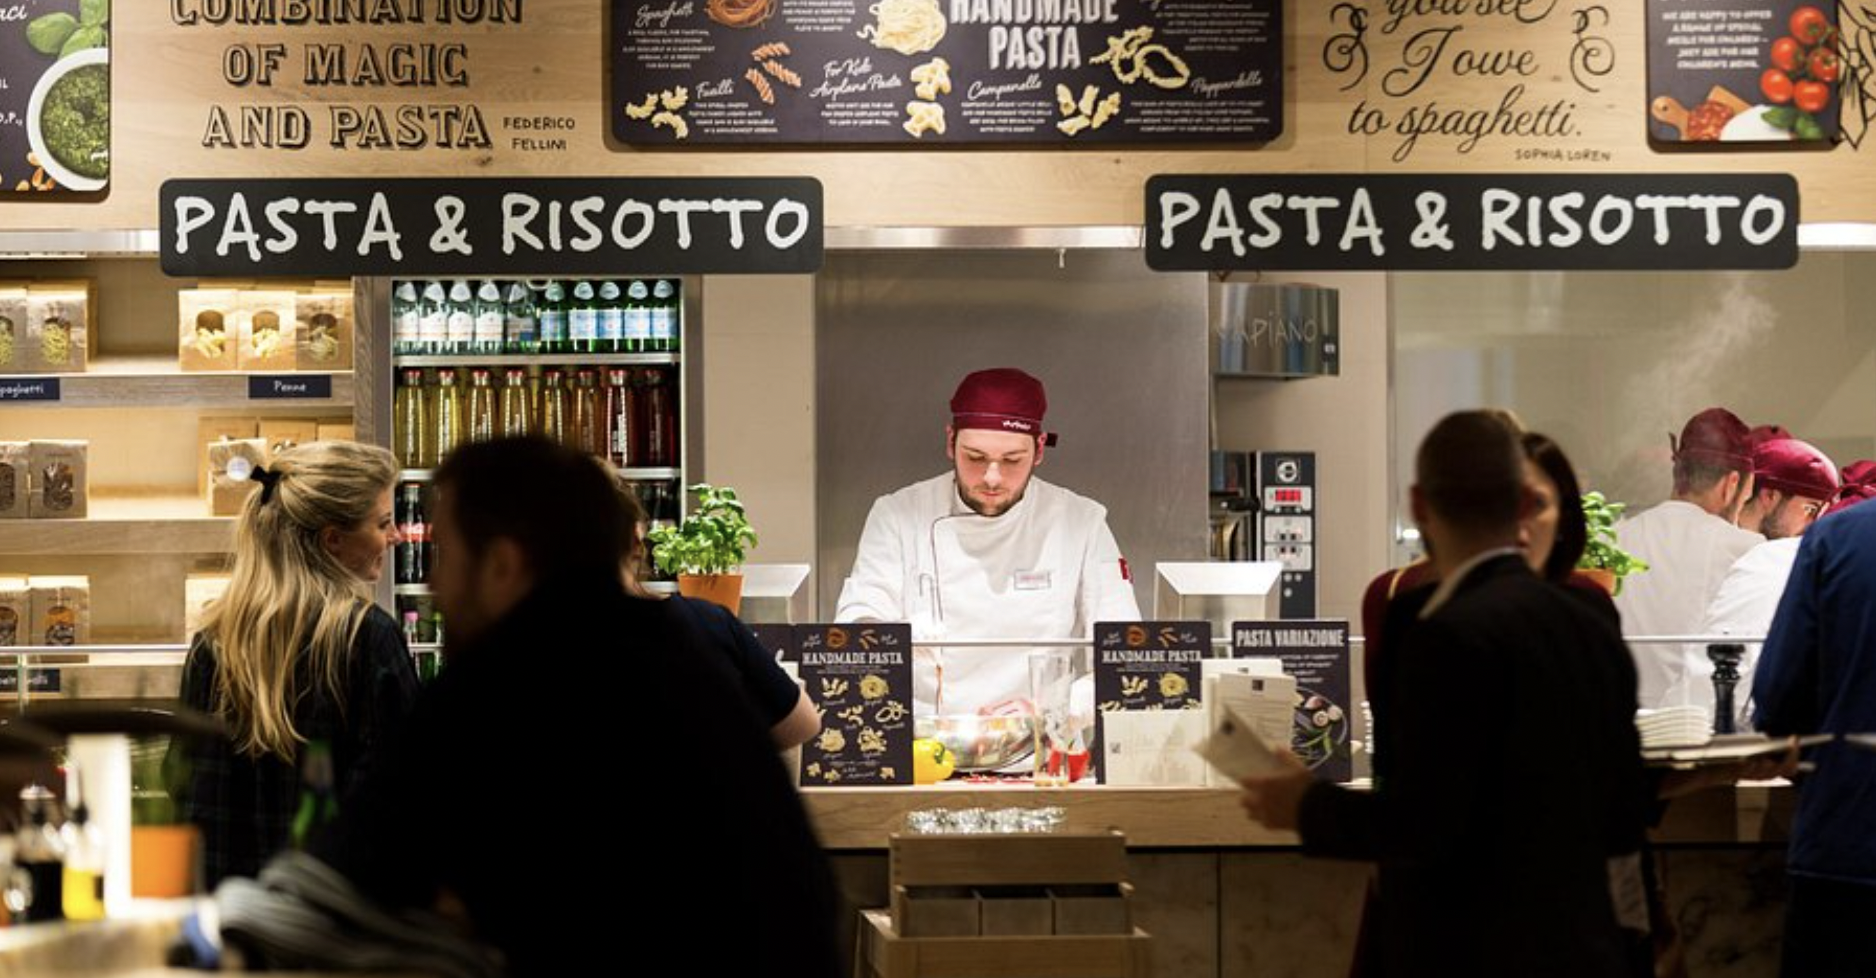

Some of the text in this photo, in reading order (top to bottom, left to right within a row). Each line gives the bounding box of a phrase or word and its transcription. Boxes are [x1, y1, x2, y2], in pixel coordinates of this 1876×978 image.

[988, 25, 1082, 70] PASTA
[222, 44, 469, 87] OF MAGIC
[1453, 49, 1539, 76] owe
[202, 105, 493, 150] AND PASTA
[503, 116, 576, 131] FEDERICO
[1348, 83, 1581, 163] to spaghetti.
[512, 137, 568, 151] FELLINI
[1515, 148, 1611, 163] SOPHIA LOREN
[174, 193, 809, 262] PASTA & RISOTTO
[1160, 188, 1785, 257] PASTA & RISOTTO
[273, 379, 307, 393] Penne
[1235, 628, 1345, 647] PASTA VARIAZIONE
[802, 652, 904, 665] HANDMADE PASTA
[1102, 650, 1202, 664] HANDMADE PASTA
